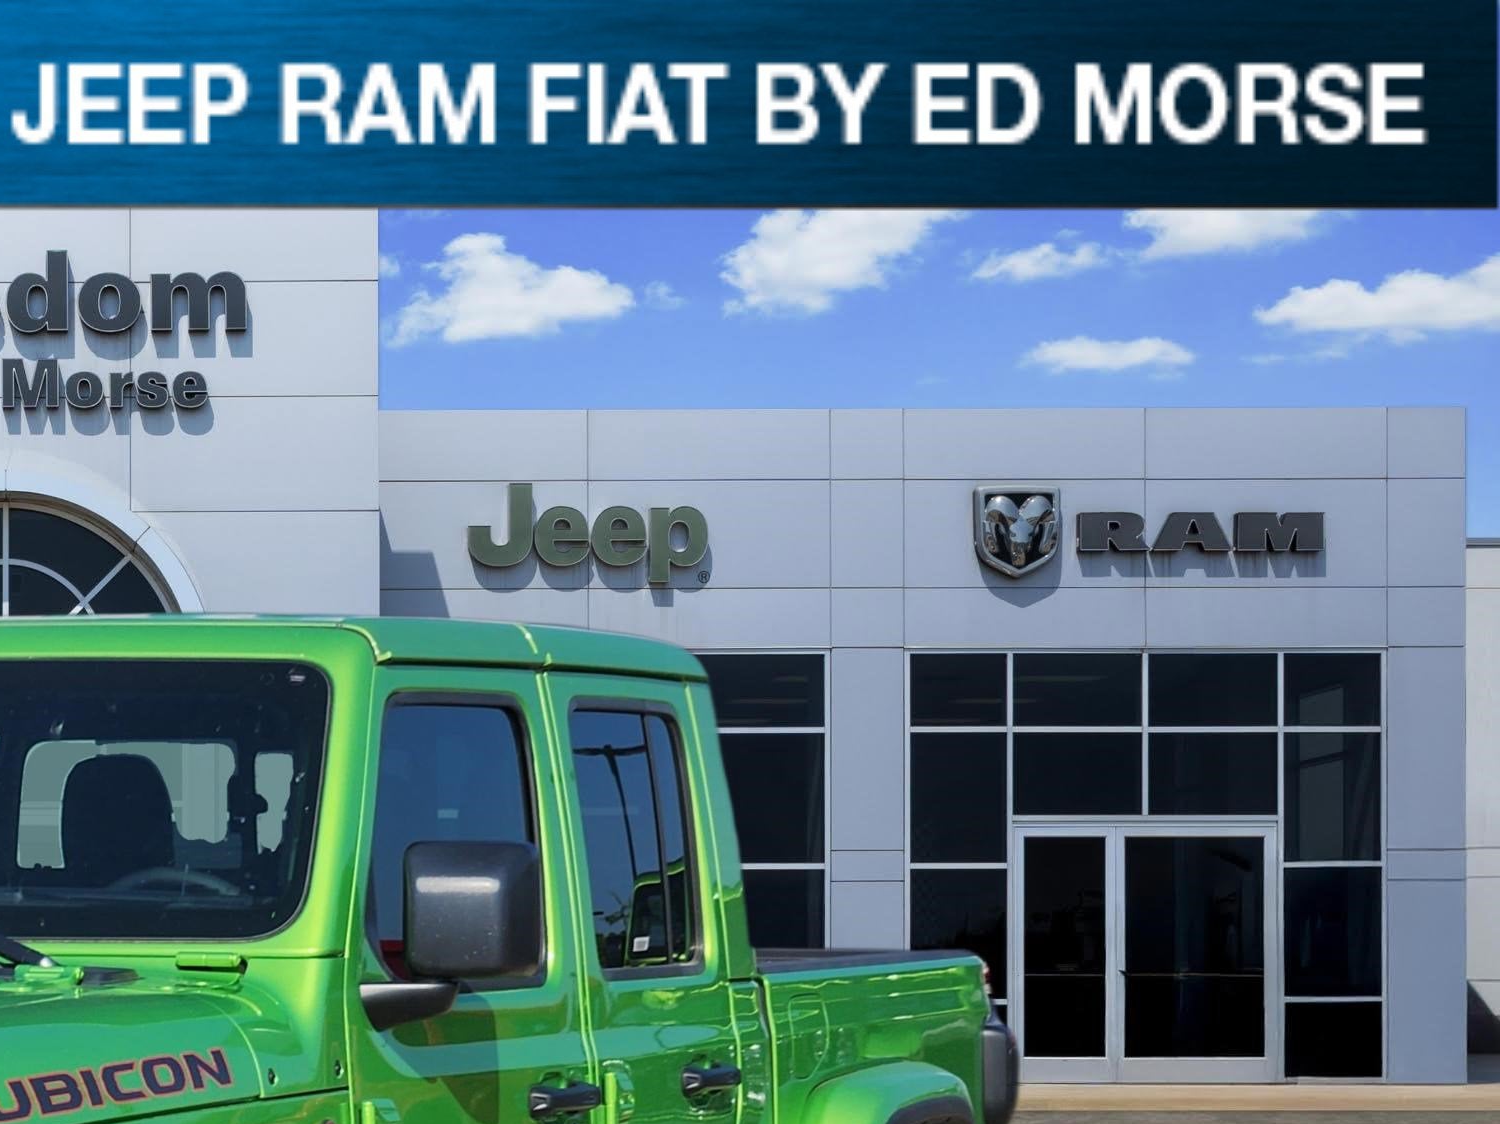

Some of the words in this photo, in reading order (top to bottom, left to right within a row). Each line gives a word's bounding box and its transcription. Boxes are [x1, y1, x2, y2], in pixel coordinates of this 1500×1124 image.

[2, 358, 209, 409] Morse
[467, 483, 709, 584] Jeep
[1076, 511, 1325, 552] RAM
